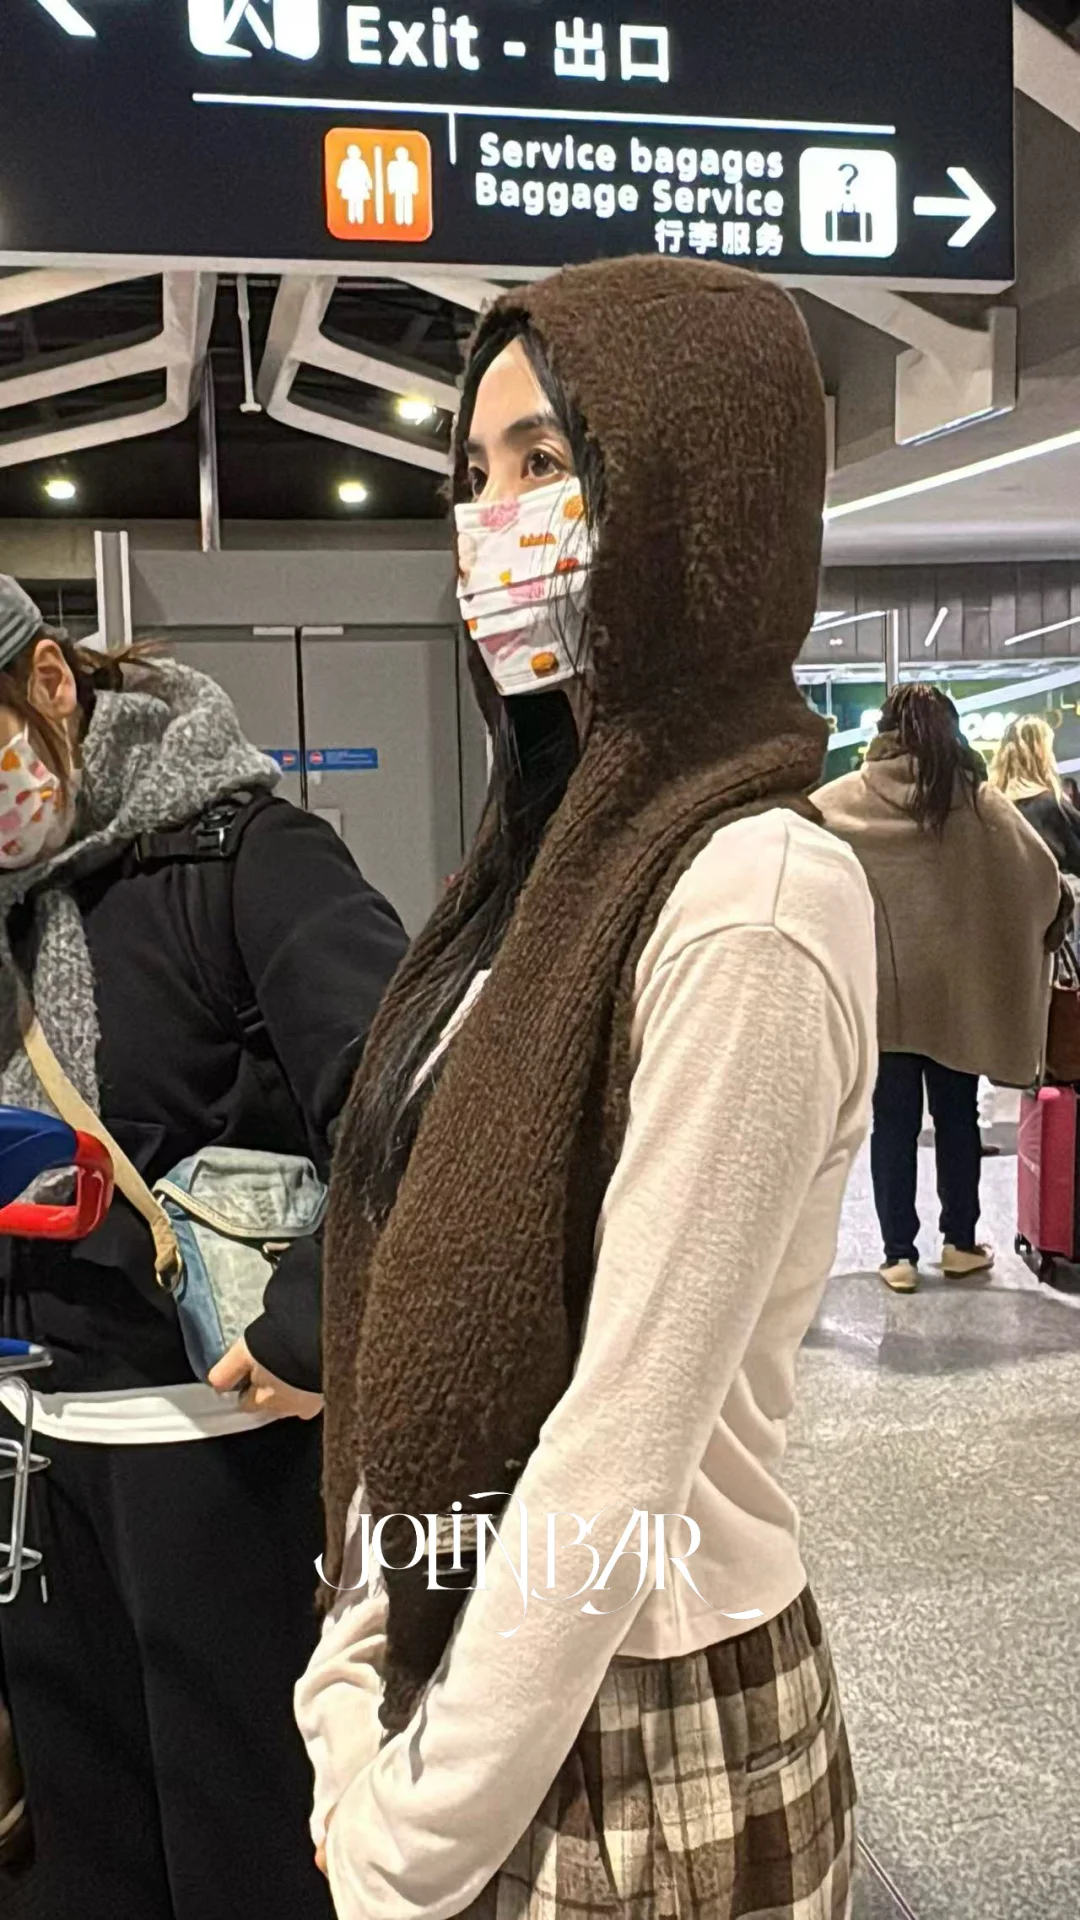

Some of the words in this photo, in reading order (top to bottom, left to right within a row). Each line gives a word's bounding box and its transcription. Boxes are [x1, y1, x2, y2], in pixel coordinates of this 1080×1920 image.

[347, 4, 480, 71] Exit
[553, 16, 671, 82] 出口
[479, 131, 617, 172] Service
[630, 136, 784, 184] bagages
[474, 171, 640, 218] Baggage
[653, 178, 785, 217] Service
[654, 217, 784, 257] 行李服务
